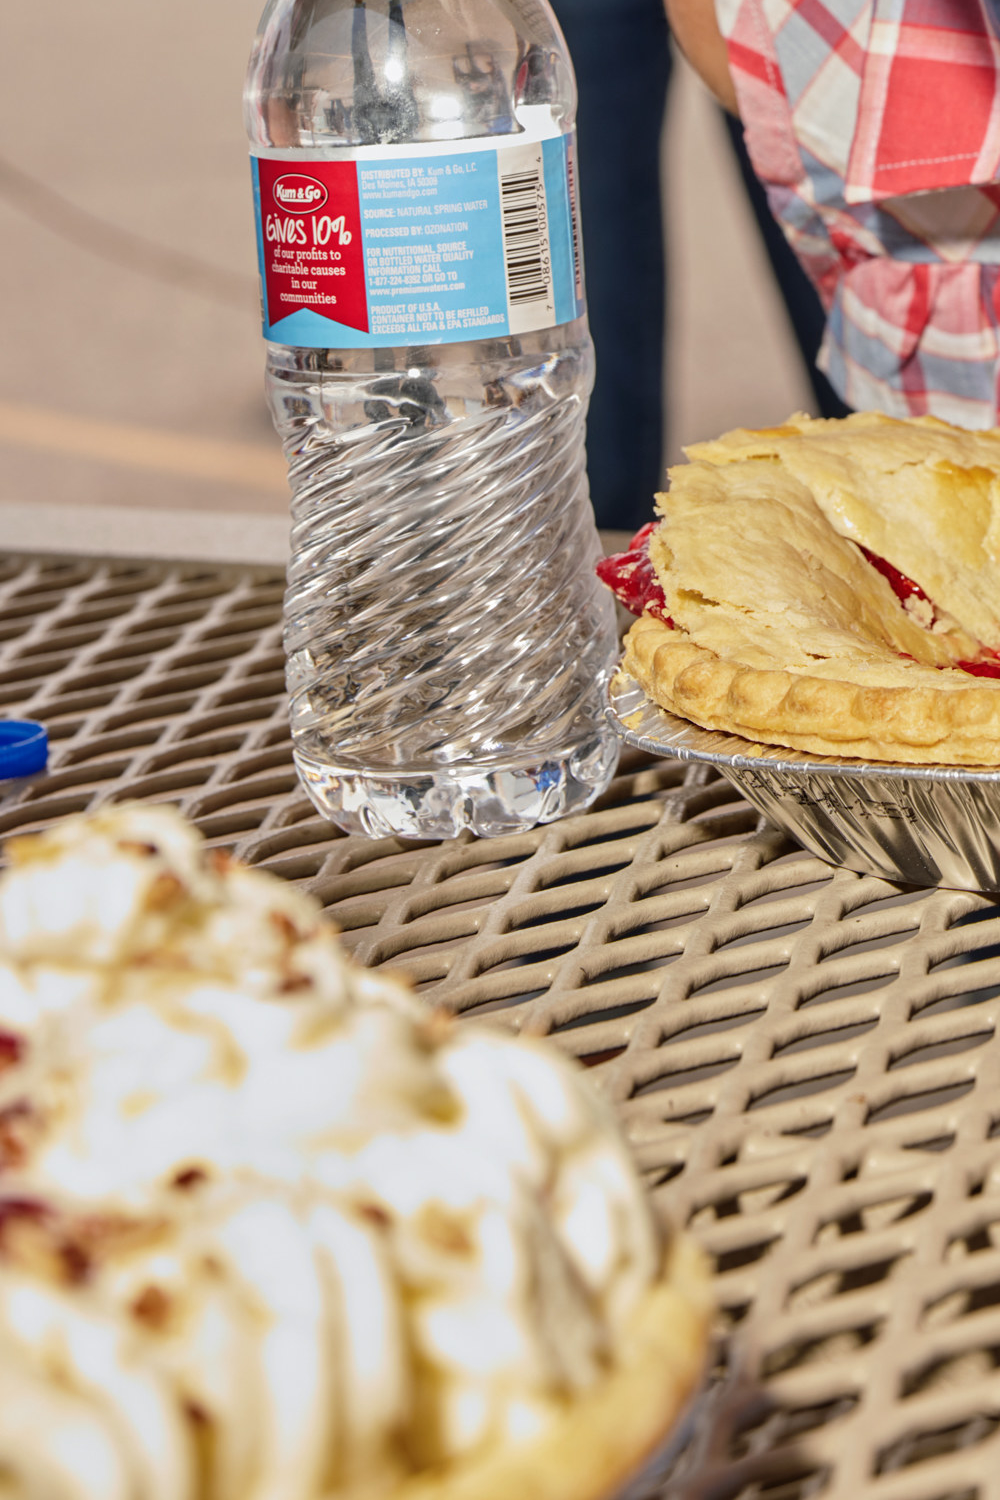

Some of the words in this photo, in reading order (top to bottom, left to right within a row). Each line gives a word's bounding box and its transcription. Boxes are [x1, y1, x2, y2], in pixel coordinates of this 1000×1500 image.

[361, 169, 410, 179] DISTRIBUTED
[412, 168, 424, 177] BY:
[428, 167, 444, 176] Kum
[446, 165, 451, 174] &
[277, 184, 296, 198] Kum
[297, 188, 304, 198] &
[305, 185, 321, 199] Go
[362, 181, 376, 190] Des
[408, 178, 416, 187] IA
[362, 188, 437, 199] www.kumandgo.com
[364, 208, 395, 219] SOURCE:
[398, 206, 432, 217] NATURAL
[434, 202, 462, 214] SPRING
[463, 200, 488, 211] WATER
[536, 183, 547, 230] 00575
[312, 216, 352, 245] 10%
[365, 226, 409, 238] PROCESSED
[411, 226, 423, 235] BY:
[425, 222, 468, 234] OZONATION
[274, 245, 281, 258] of
[282, 249, 294, 259] our
[296, 248, 328, 262] profits
[330, 250, 341, 260] to
[367, 248, 380, 257] FOR
[437, 241, 466, 252] SOURCE
[368, 258, 378, 266] OR
[380, 256, 412, 266] BOTTLED
[414, 253, 441, 263] WATER
[443, 250, 474, 262] QUALITY
[540, 238, 551, 285] 08615
[272, 260, 309, 275] charitable
[311, 267, 346, 275] causes
[368, 266, 420, 276] INFORMATION
[422, 263, 441, 273] CALL
[291, 277, 300, 288] in
[301, 281, 317, 289] our
[422, 274, 433, 282] OR
[435, 273, 445, 282] GO
[447, 272, 457, 280] TO
[280, 292, 336, 304] communities
[371, 305, 406, 315] PRODUCT
[408, 304, 417, 312] OF
[372, 314, 414, 324] CONTAINER
[416, 312, 432, 322] NOT
[435, 311, 444, 320] TO
[446, 310, 456, 319] BE
[458, 307, 489, 318] REFILLED
[372, 324, 405, 334] EXCEEDS
[408, 323, 421, 332] ALL
[423, 322, 438, 331] FDA
[439, 321, 445, 330] &
[447, 319, 461, 329] EPA
[463, 314, 504, 328] STANDARDS
